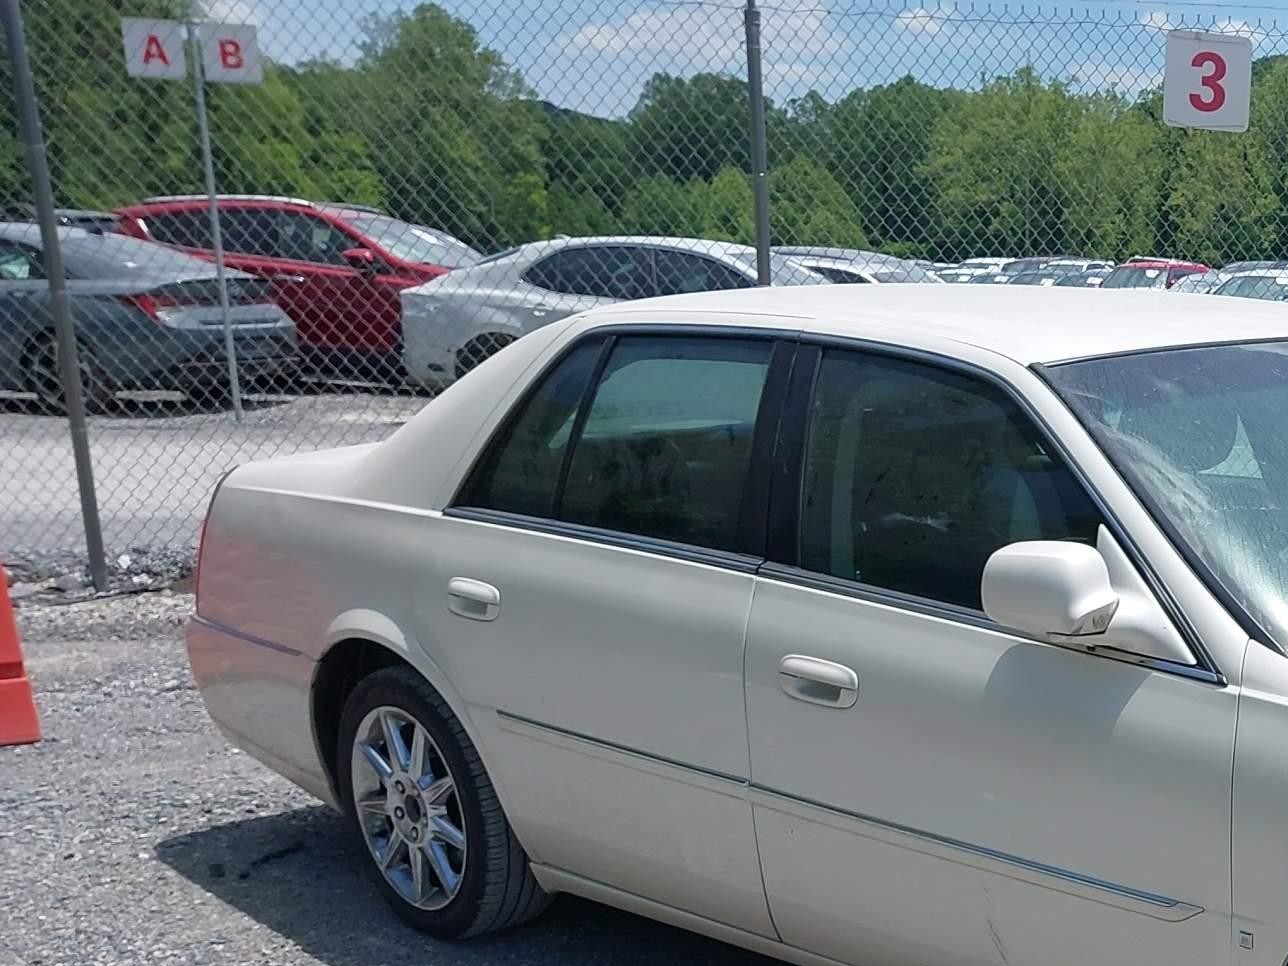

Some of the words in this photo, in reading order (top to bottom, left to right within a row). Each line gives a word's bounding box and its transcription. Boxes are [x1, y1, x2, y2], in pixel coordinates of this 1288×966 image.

[143, 34, 170, 66] A
[219, 39, 243, 69] B
[1188, 51, 1227, 112] 3
